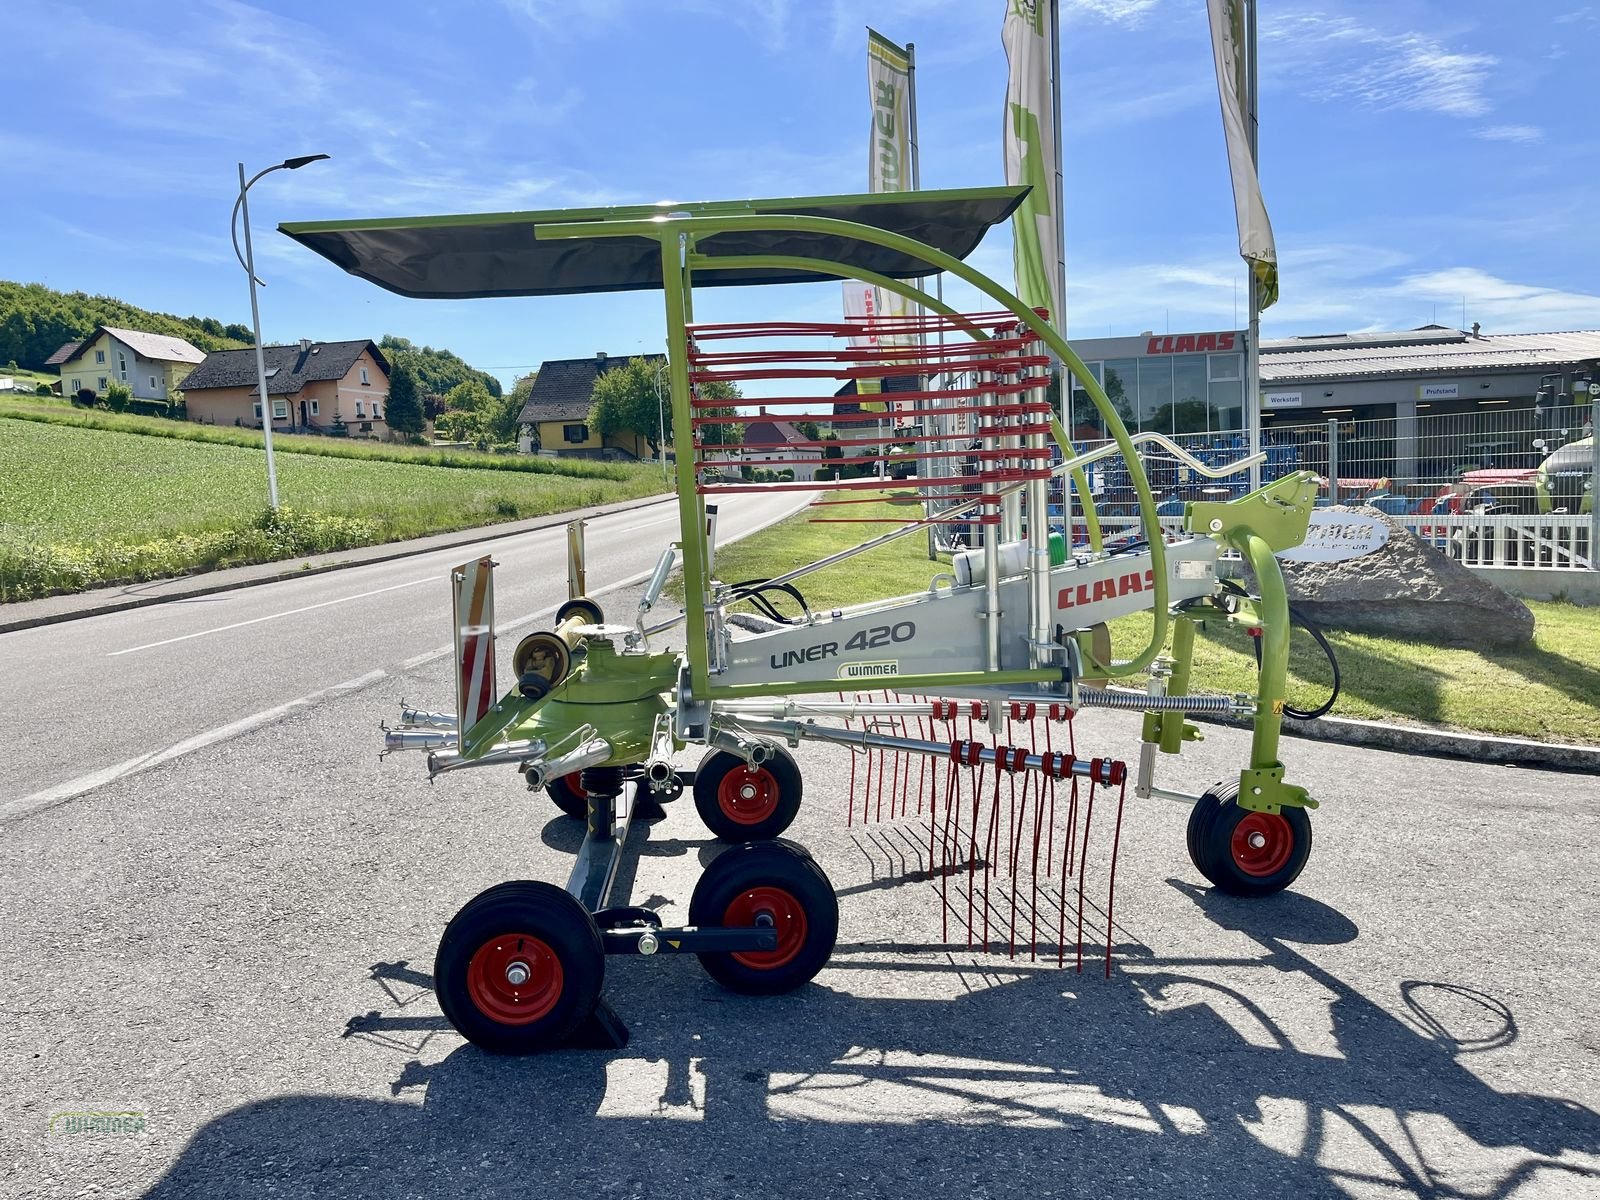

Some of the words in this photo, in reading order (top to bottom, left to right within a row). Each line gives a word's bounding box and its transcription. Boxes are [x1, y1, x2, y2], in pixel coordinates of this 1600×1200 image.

[1147, 333, 1235, 354] CLAAS
[770, 642, 838, 669] LINER
[844, 621, 916, 650] 420
[848, 664, 897, 676] WIMMER
